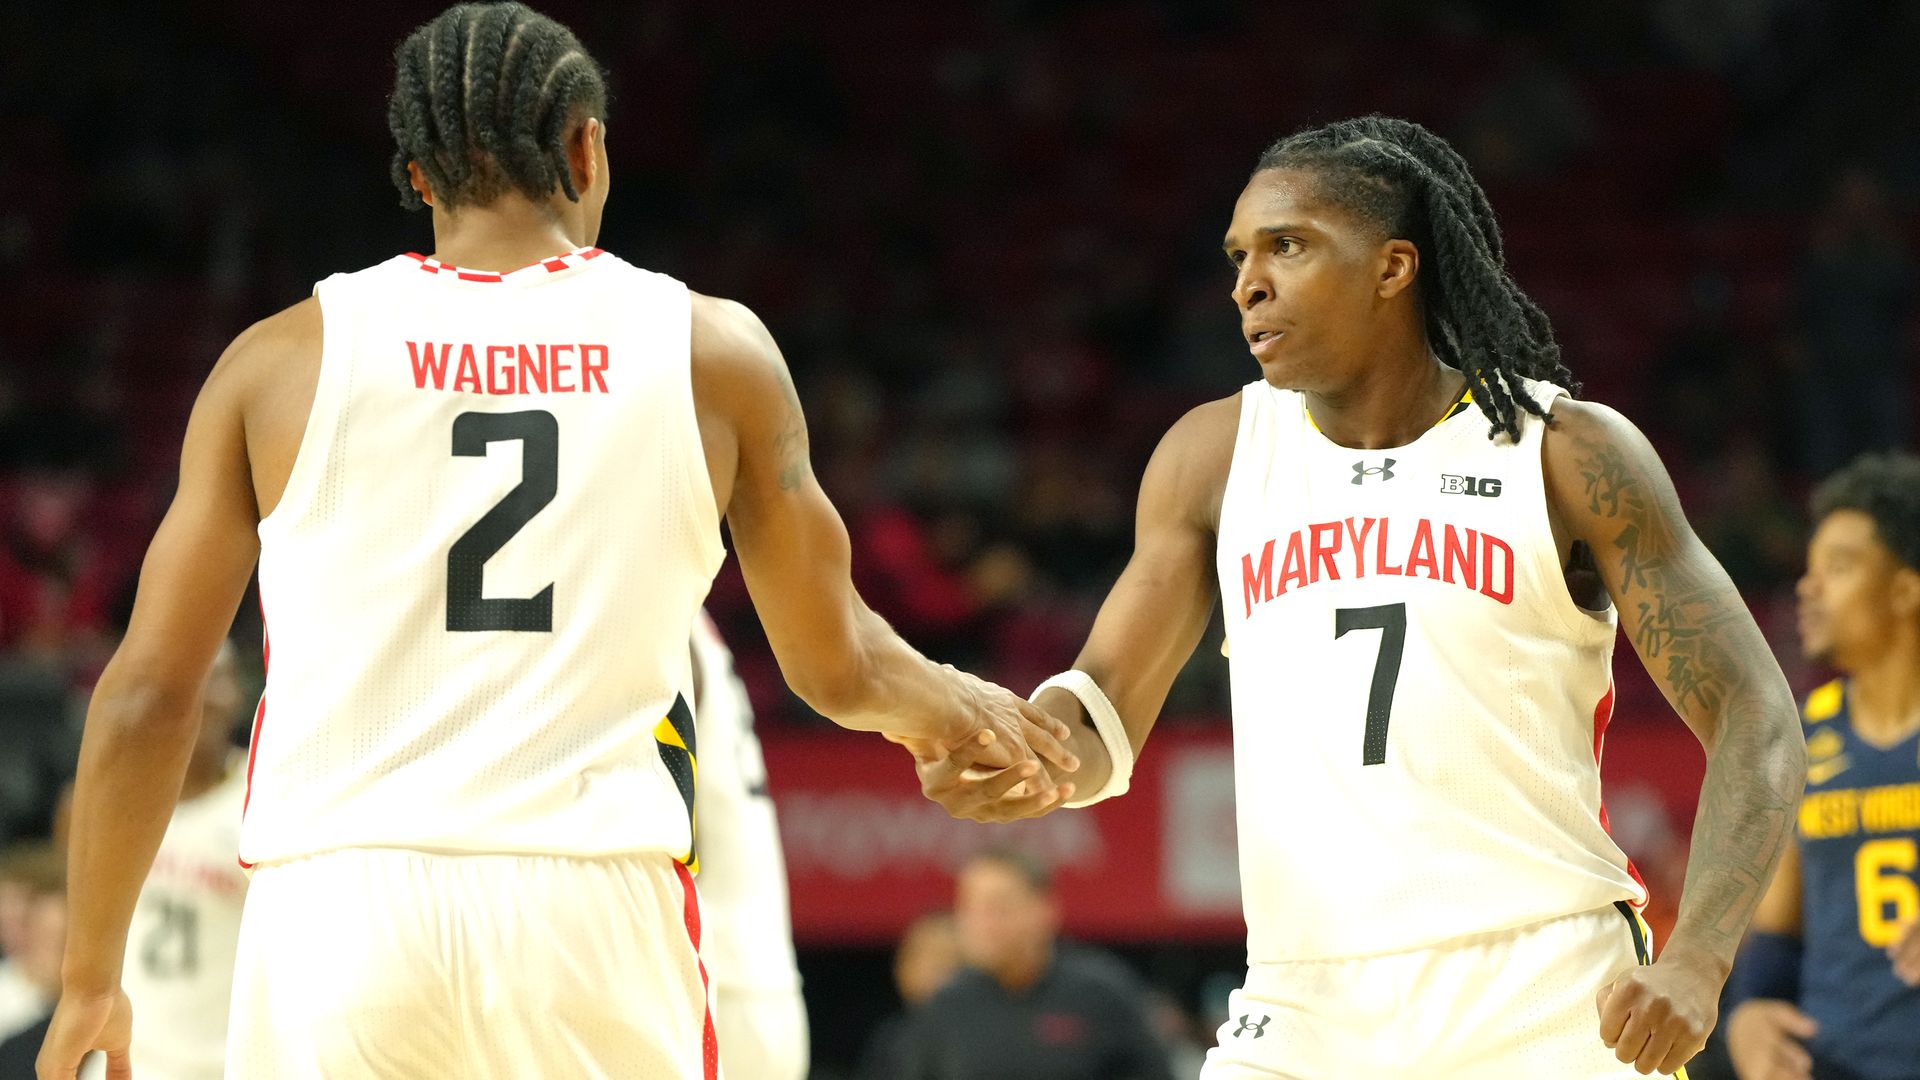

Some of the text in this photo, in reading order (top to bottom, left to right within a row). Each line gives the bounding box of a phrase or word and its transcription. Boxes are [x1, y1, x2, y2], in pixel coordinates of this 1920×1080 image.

[406, 342, 609, 396] WAGNER
[445, 409, 559, 632] 2
[1241, 516, 1515, 620] MARYLAND
[1334, 602, 1407, 766] 7
[1855, 839, 1918, 947] 6
